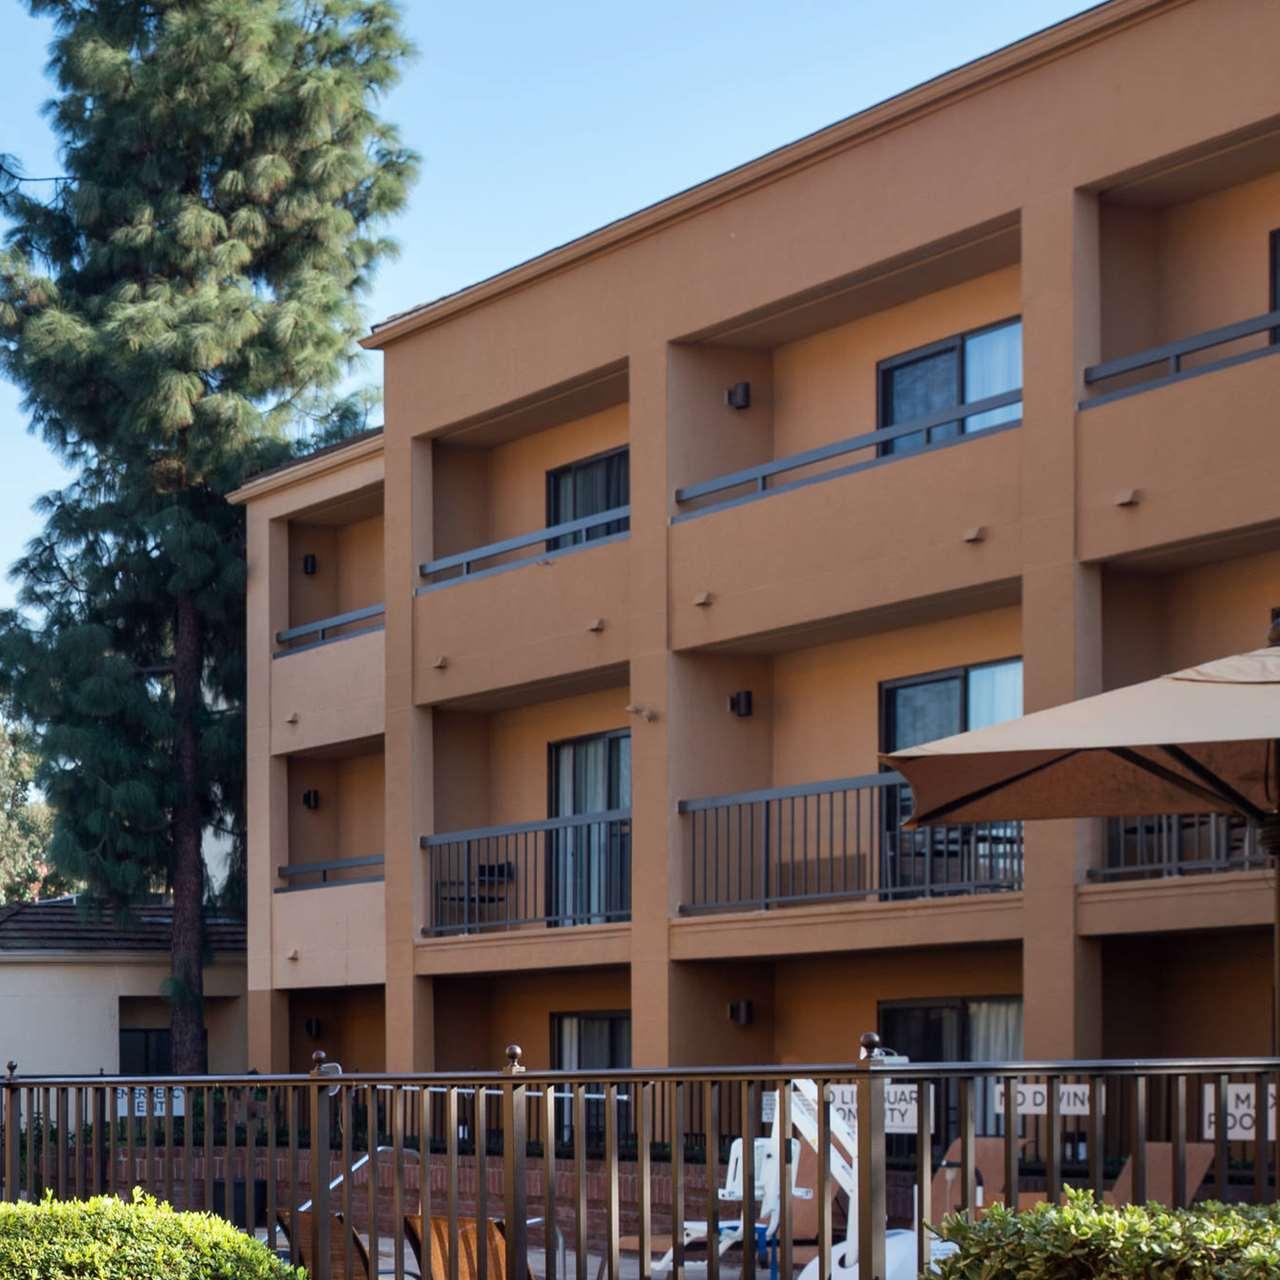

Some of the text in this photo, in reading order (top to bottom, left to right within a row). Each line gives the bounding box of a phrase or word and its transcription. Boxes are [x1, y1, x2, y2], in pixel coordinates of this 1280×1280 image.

[117, 1088, 185, 1099] EMEREC
[841, 1090, 918, 1105] LIUAR
[1033, 1091, 1089, 1106] DIN
[1235, 1093, 1277, 1109] MX
[137, 1101, 165, 1112] EIT
[1208, 1112, 1255, 1130] POO
